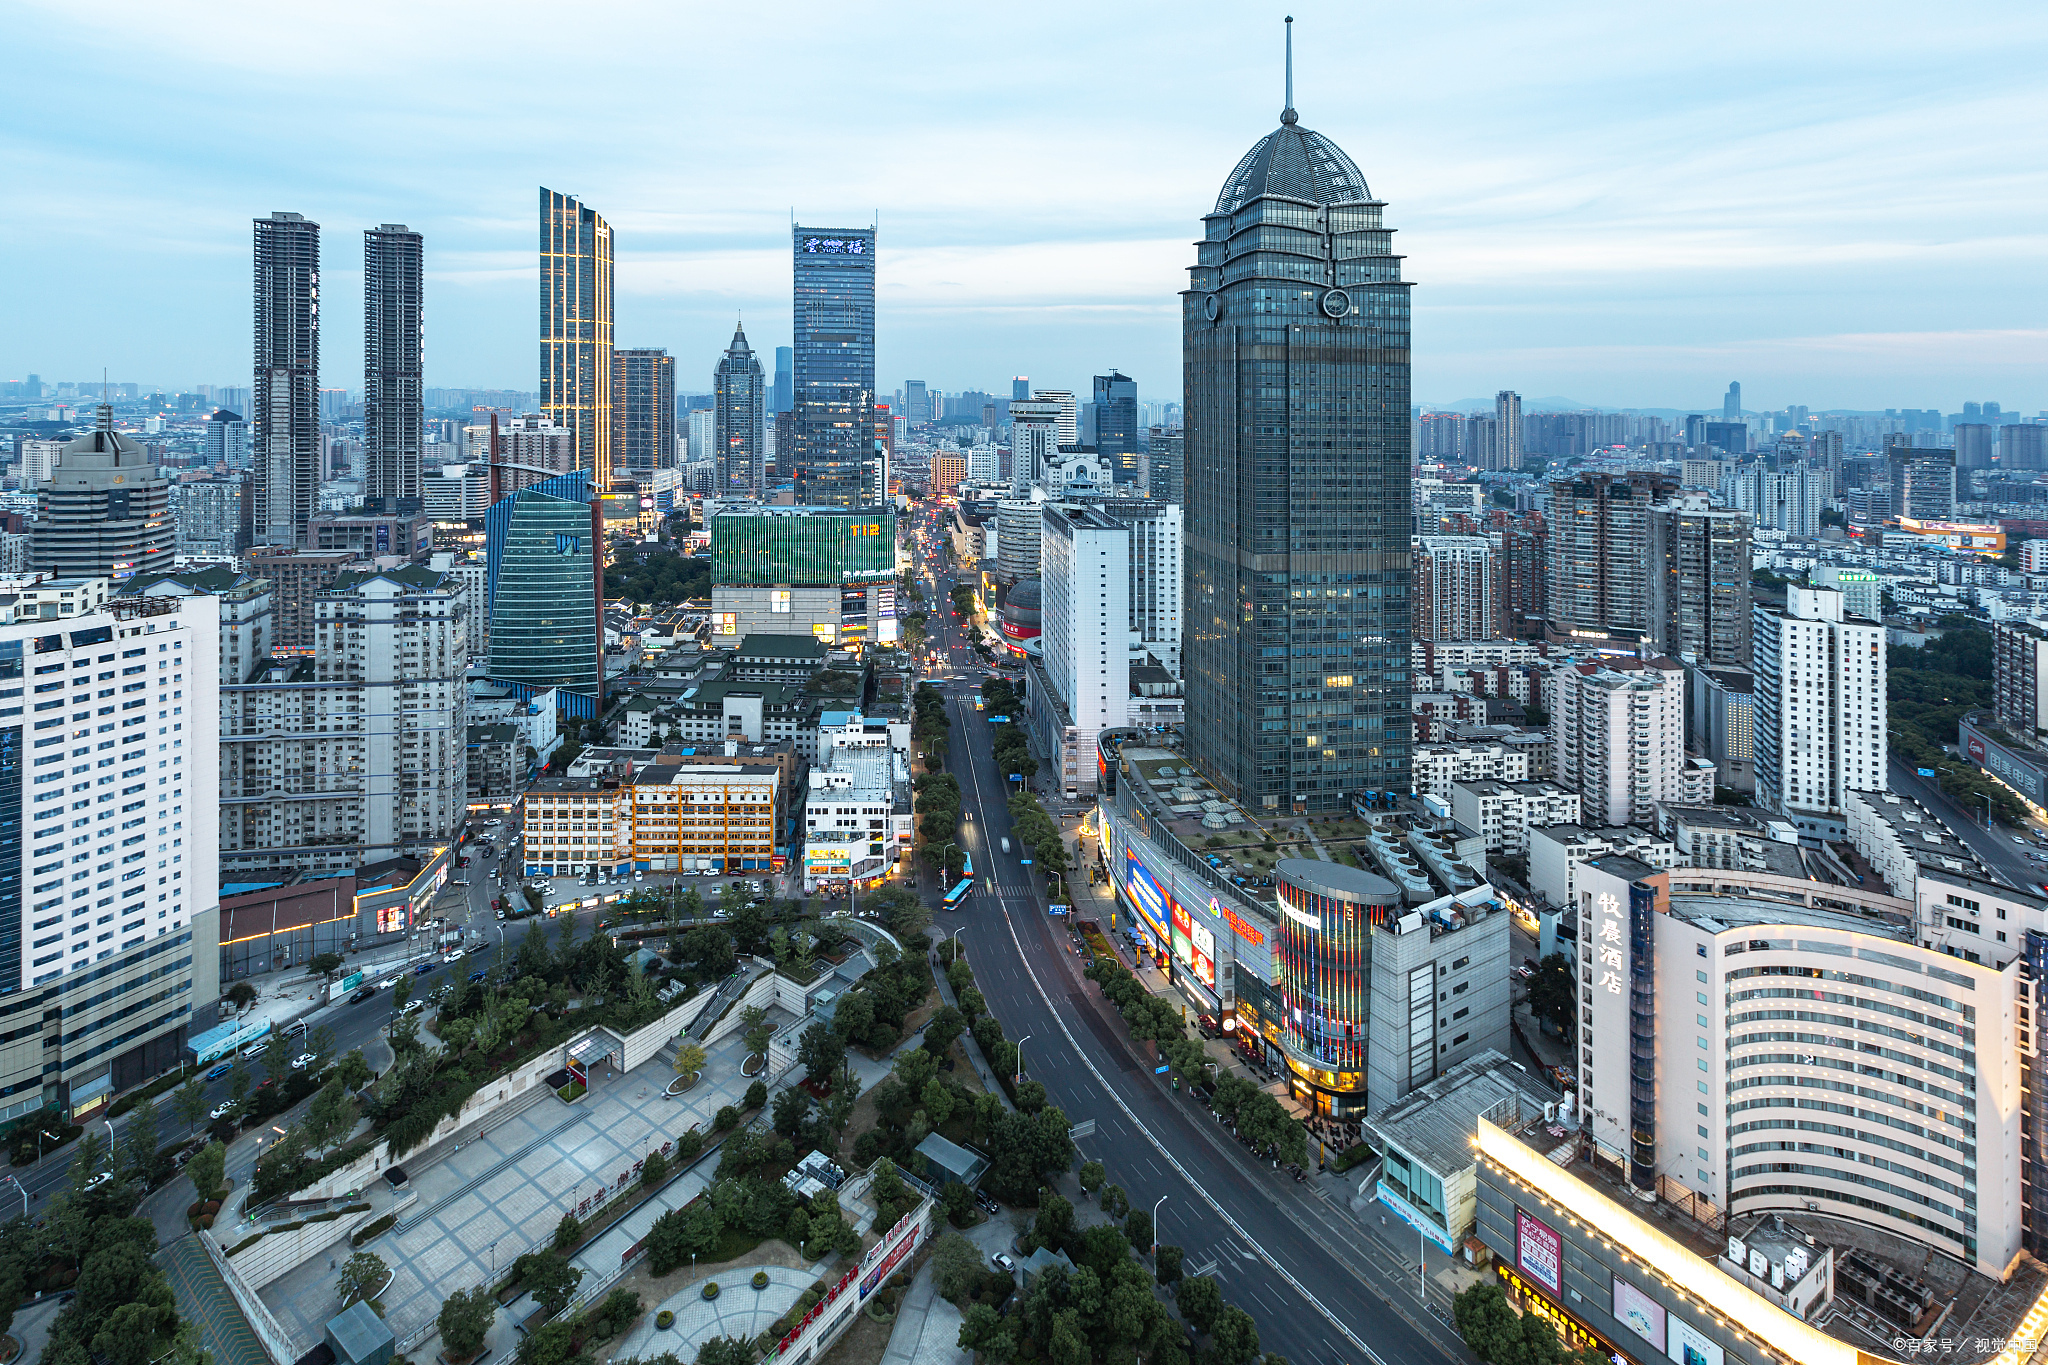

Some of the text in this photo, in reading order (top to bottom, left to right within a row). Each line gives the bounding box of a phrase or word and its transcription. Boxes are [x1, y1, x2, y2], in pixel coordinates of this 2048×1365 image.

[850, 524, 880, 537] T12
[1990, 752, 2037, 795] 国美电器
[1521, 1216, 1557, 1248] 苏宁易购
